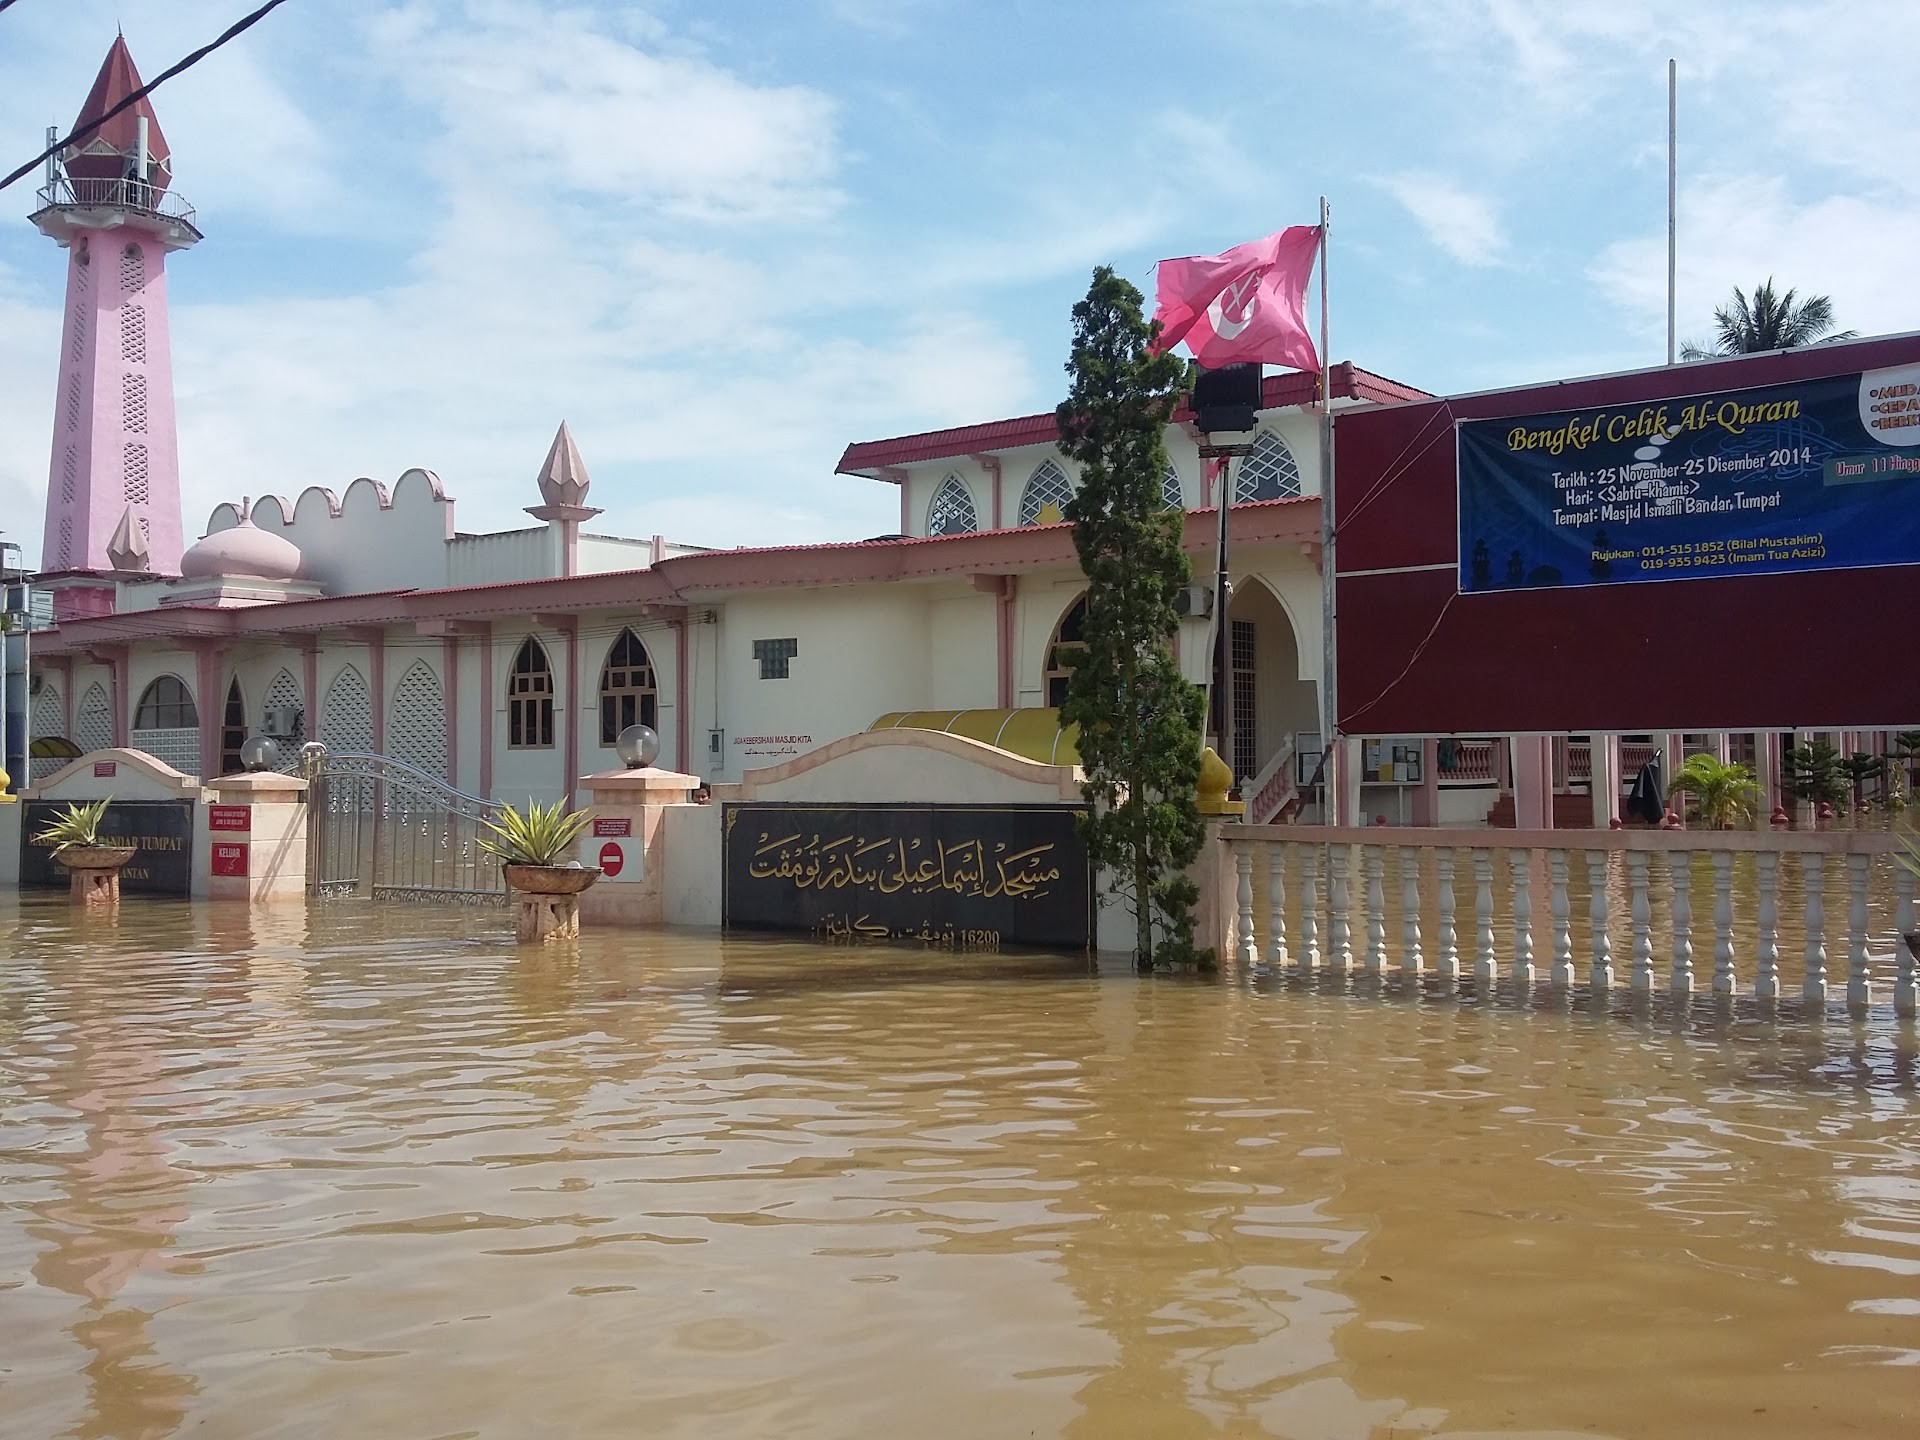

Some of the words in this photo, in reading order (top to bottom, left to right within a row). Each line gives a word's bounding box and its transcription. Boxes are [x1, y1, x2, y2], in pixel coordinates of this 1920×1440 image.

[1878, 384, 1920, 400] MUD
[1508, 414, 1606, 455] Bengkel
[1607, 405, 1674, 442] Celik
[1672, 399, 1800, 438] Al-Quran
[1879, 414, 1920, 430] BERK
[1552, 471, 1587, 489] Tarikh
[1596, 468, 1616, 485] 25
[1708, 453, 1766, 473] Disember
[1769, 446, 1812, 467] 2014
[1836, 461, 1865, 476] Umur
[1565, 491, 1594, 507] Hari:
[1553, 506, 1598, 528] Tempat:
[1601, 503, 1641, 525] Masjid
[1644, 499, 1682, 518] Ismaili
[1685, 495, 1734, 514] Bandar,
[1734, 491, 1781, 512] Tumpat
[1591, 549, 1635, 562] Rujukan
[1641, 544, 1692, 558] 014-515
[1694, 541, 1725, 553] 1852
[1726, 537, 1757, 552] (Bilal
[1759, 532, 1824, 549] Mustakim)
[1640, 557, 1691, 570] 019-935
[1693, 554, 1726, 566] 9423
[1727, 550, 1765, 565] (Imam
[1767, 550, 1789, 560] Tua
[1791, 544, 1827, 559] Azizi)
[775, 735, 797, 744] MASJID
[797, 735, 812, 743] KITA
[141, 836, 184, 851] TUMPAT
[960, 929, 1000, 944] 16200
